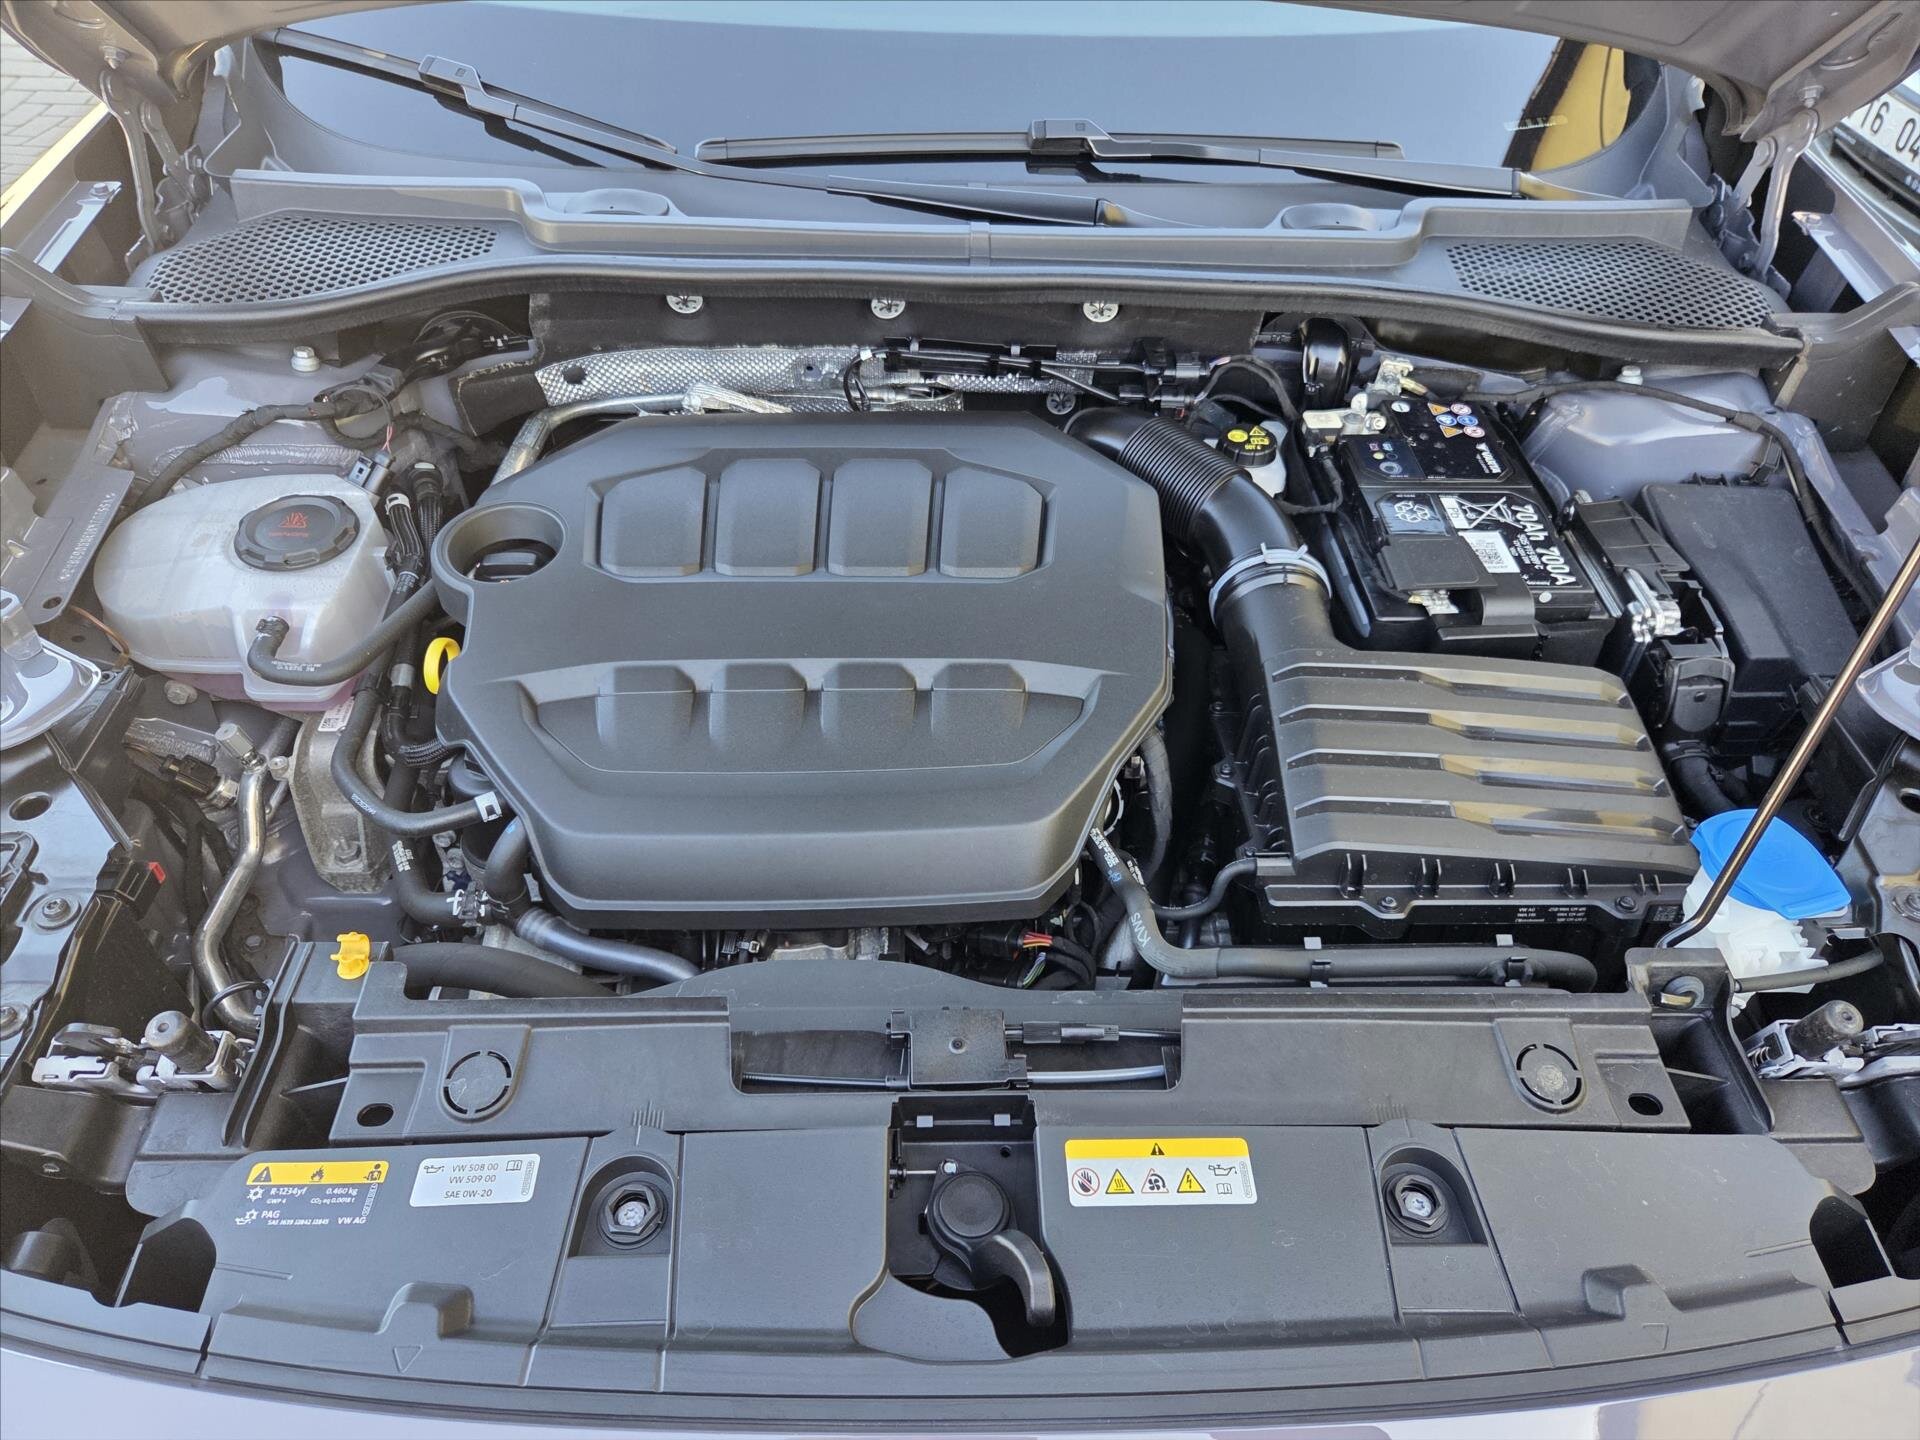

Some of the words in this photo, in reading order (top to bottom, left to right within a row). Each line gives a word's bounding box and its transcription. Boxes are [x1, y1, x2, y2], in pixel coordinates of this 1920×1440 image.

[1511, 504, 1548, 541] 70Ah
[1535, 546, 1577, 586] 700A
[468, 1164, 485, 1172] 508
[487, 1163, 499, 1171] 00
[449, 1176, 463, 1184] VW
[466, 1175, 483, 1183] 509
[484, 1174, 497, 1182] 00
[269, 1187, 308, 1197] R-1234yf
[326, 1187, 347, 1195] 0.460
[348, 1186, 359, 1196] kg
[444, 1190, 461, 1199] SAE
[462, 1189, 493, 1198] 0W-20
[260, 1210, 281, 1219] PAG
[337, 1216, 351, 1225] VW
[352, 1216, 367, 1225] AG
